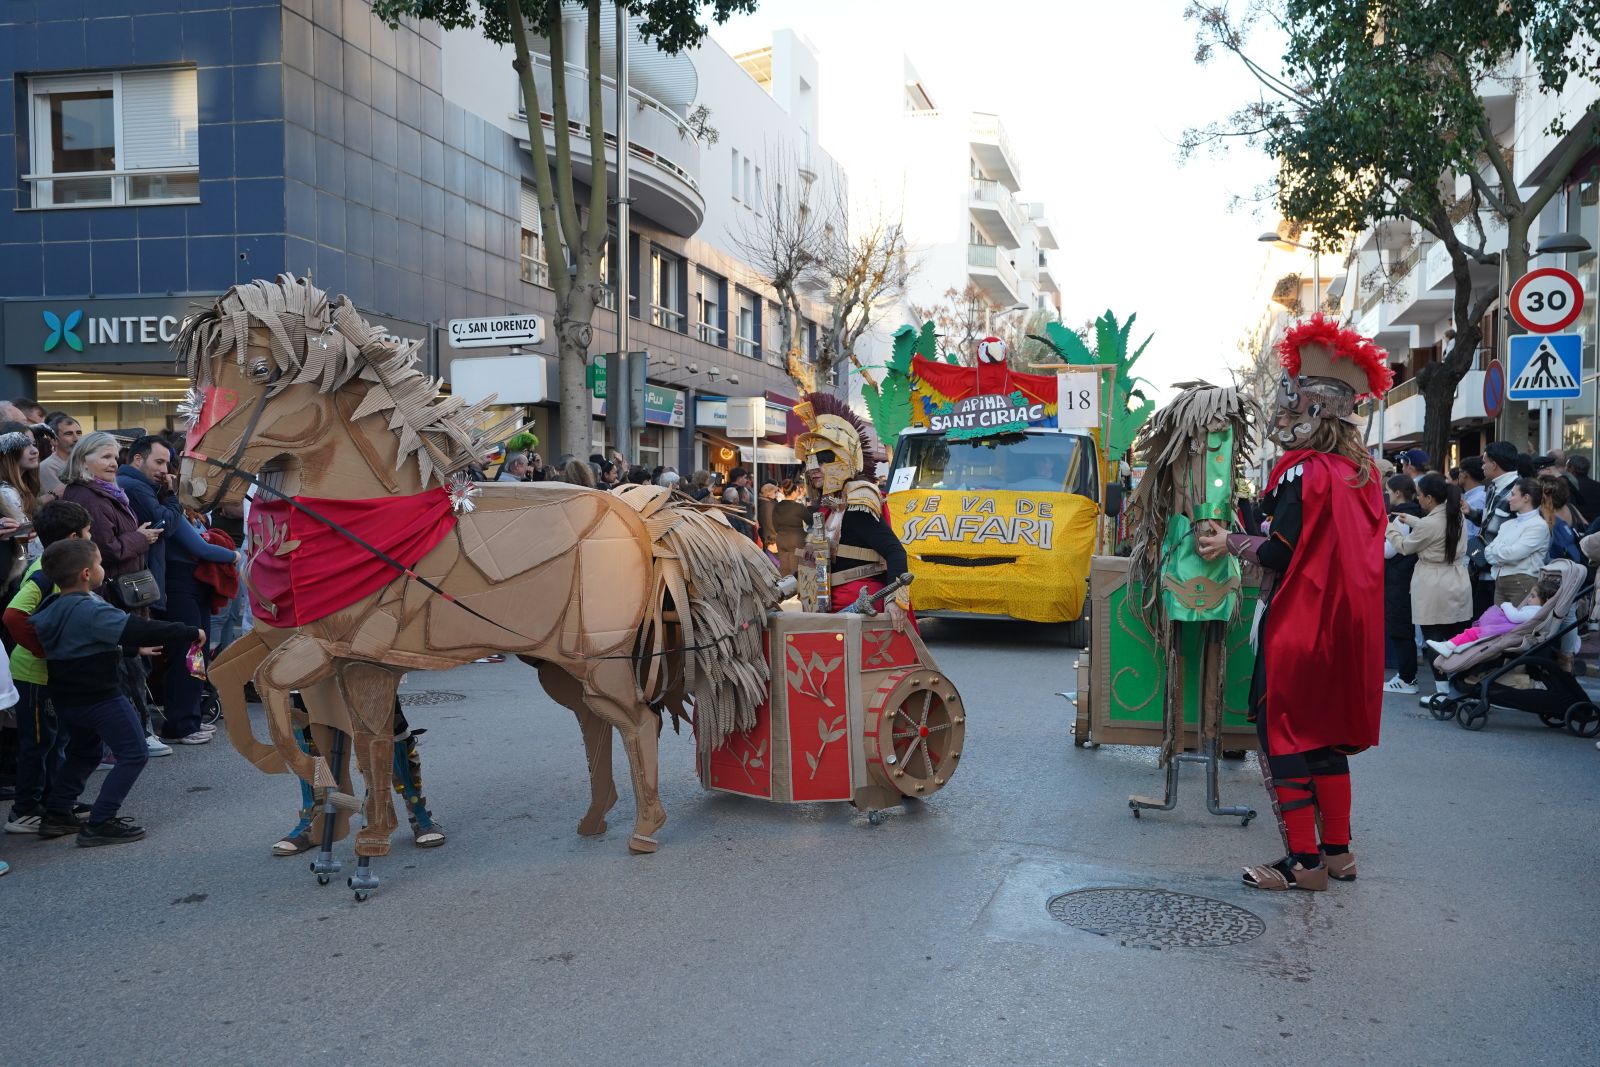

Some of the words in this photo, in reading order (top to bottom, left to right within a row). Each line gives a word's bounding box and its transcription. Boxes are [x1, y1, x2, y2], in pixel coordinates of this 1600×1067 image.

[1526, 290, 1567, 313] 30
[88, 315, 195, 344] INTEC
[452, 323, 466, 335] C/.
[468, 322, 488, 334] SAN
[491, 319, 536, 332] LORENZO
[1067, 389, 1090, 410] 18
[931, 413, 975, 431] SANT
[980, 404, 1042, 426] CIRIAC
[904, 496, 941, 514] SE
[961, 496, 996, 514] VA
[1016, 499, 1053, 518] DE
[901, 514, 1054, 550] SAFARI
